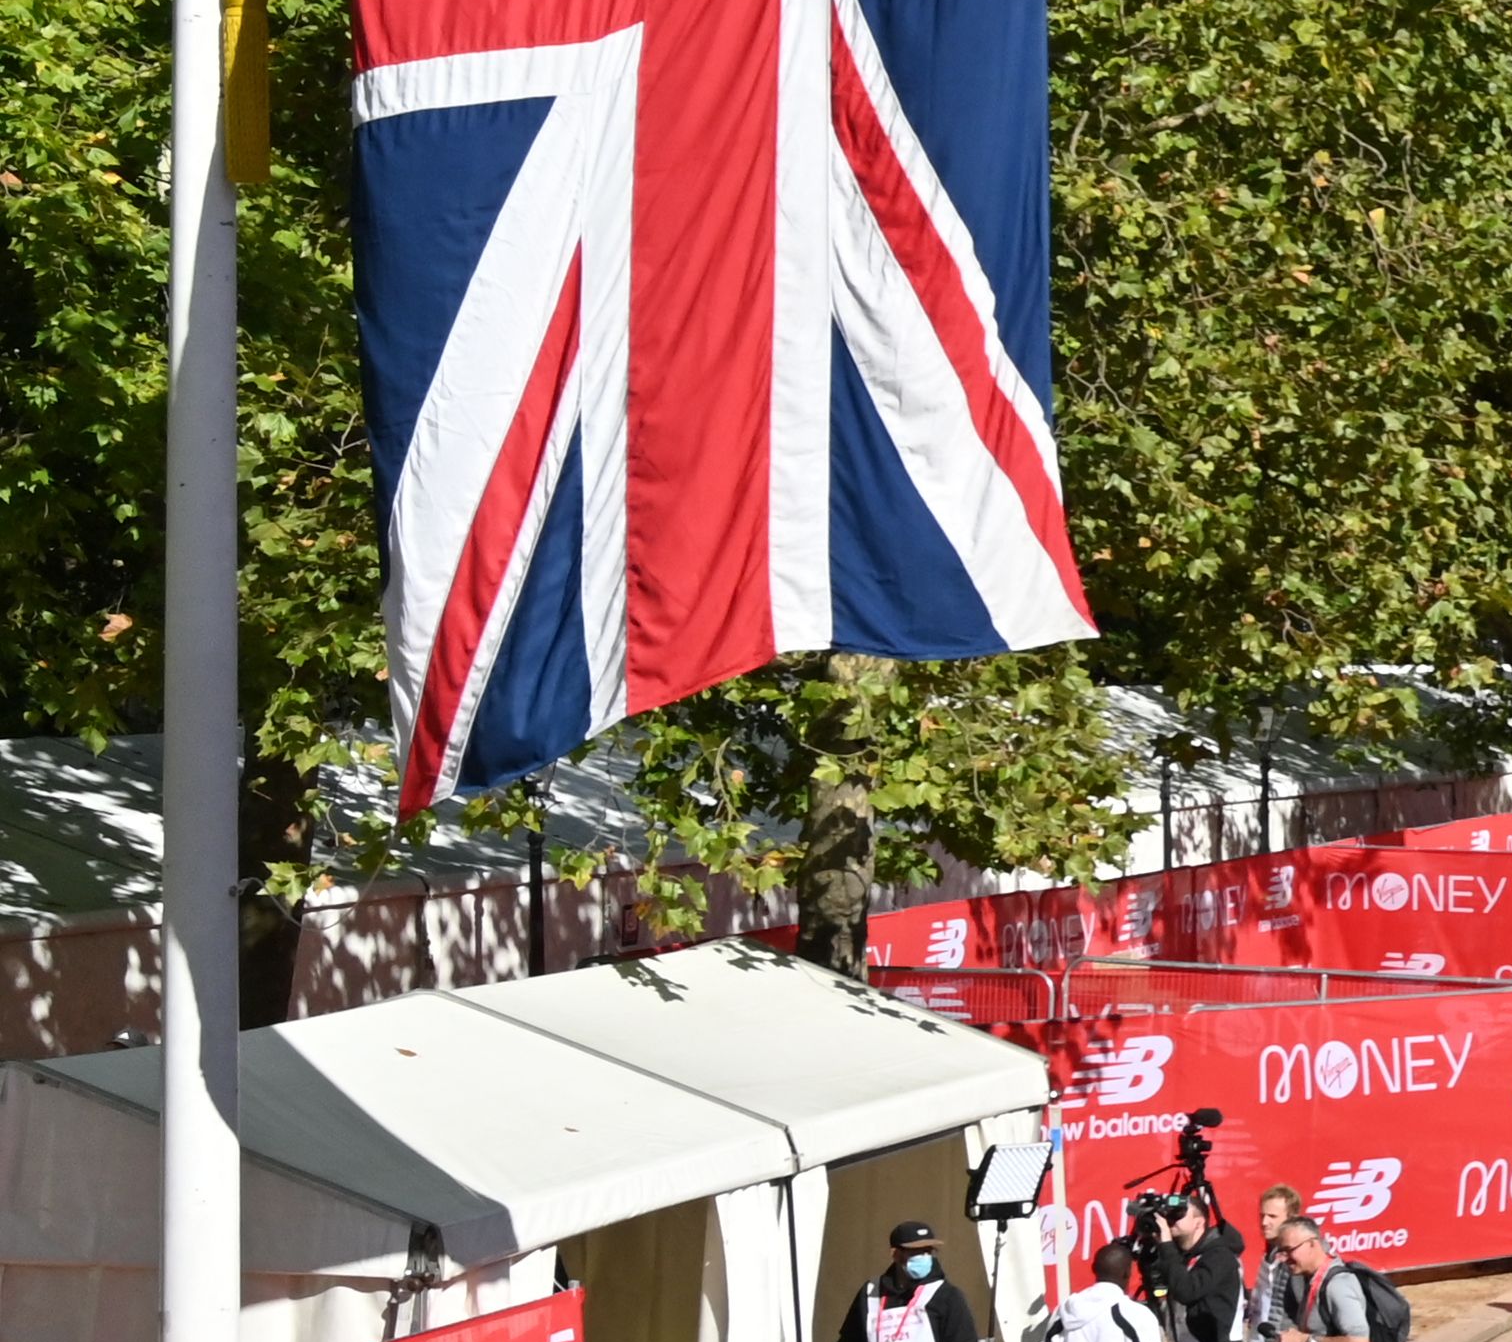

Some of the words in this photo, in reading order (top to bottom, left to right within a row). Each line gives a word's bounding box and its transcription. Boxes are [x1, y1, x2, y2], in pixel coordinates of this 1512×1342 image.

[1325, 872, 1507, 914] MONEY
[1259, 1032, 1473, 1105] MONEY
[1090, 1108, 1189, 1138] balance
[1325, 1226, 1409, 1255] balance
